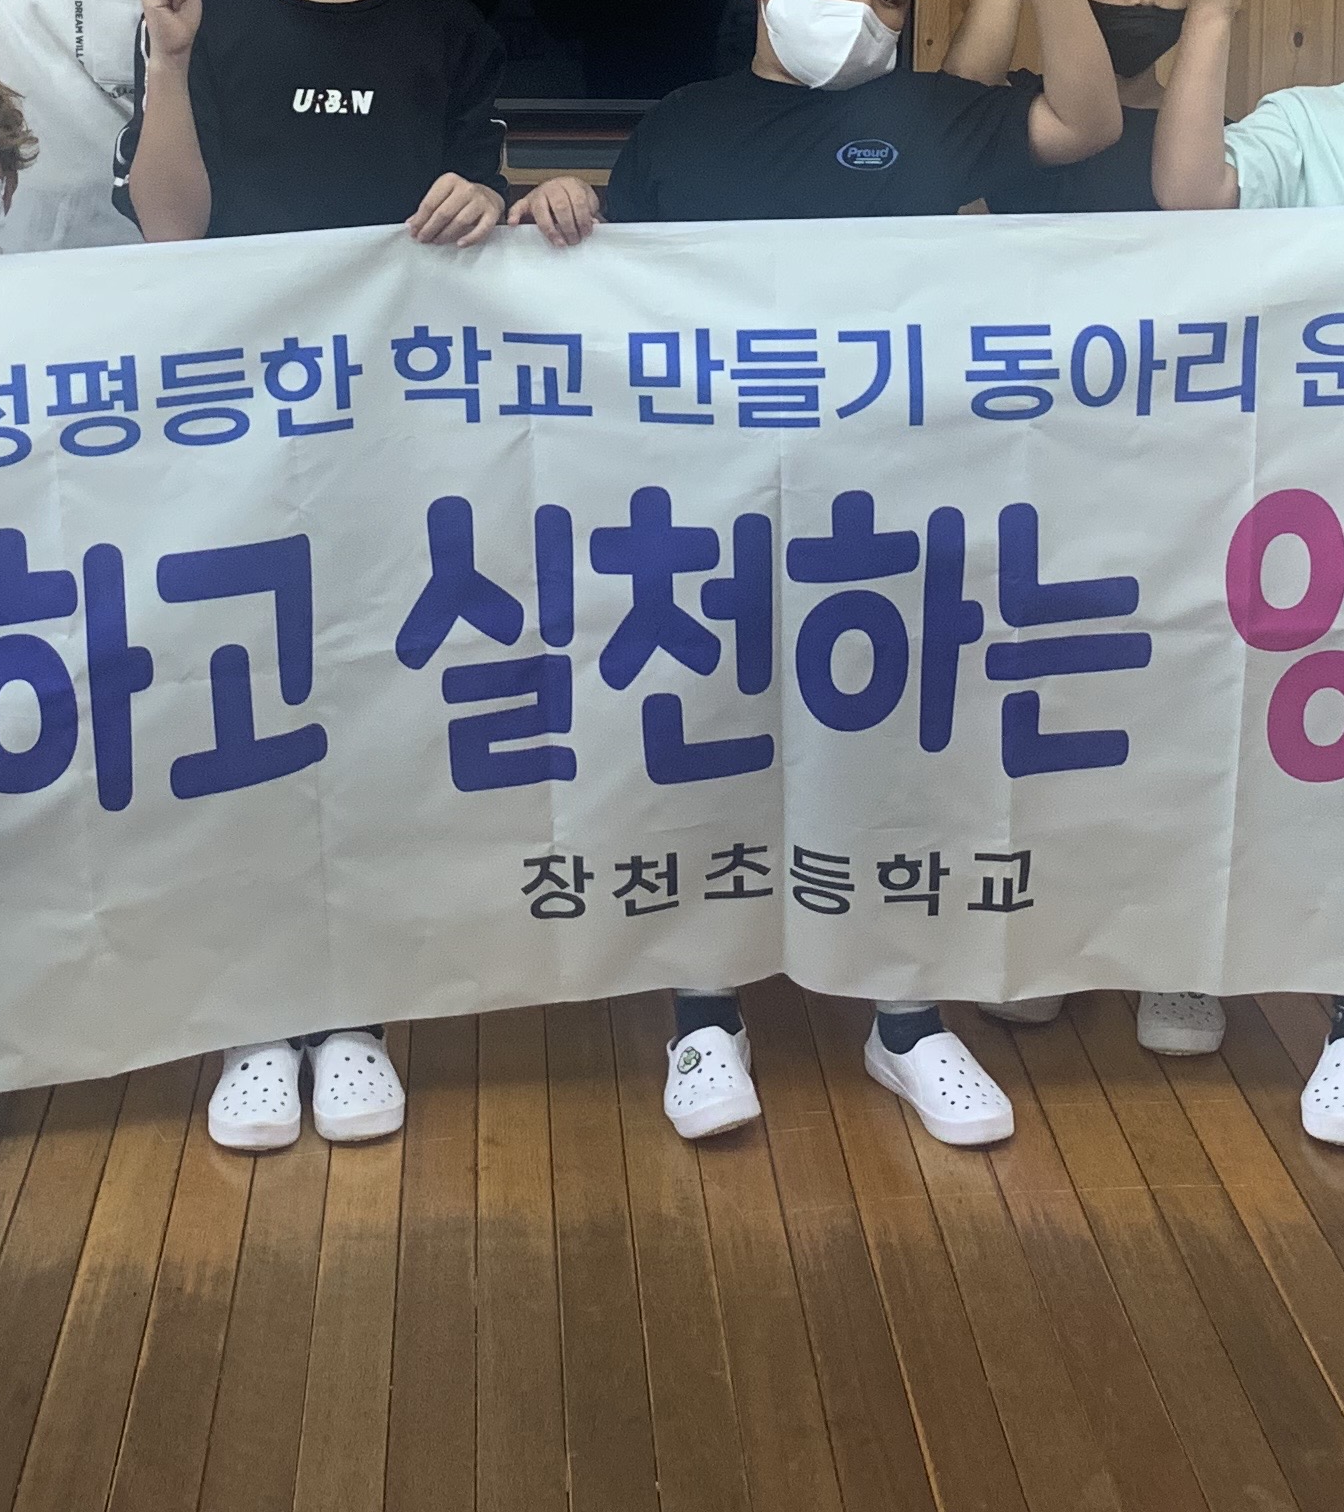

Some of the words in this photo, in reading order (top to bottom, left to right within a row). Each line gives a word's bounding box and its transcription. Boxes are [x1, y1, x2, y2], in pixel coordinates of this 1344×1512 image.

[74, 0, 84, 34] DREAM
[75, 35, 84, 59] WILL
[847, 146, 890, 158] Proud
[391, 325, 594, 425] 학교
[627, 323, 926, 430] 만들기
[964, 316, 1259, 421] 동아리
[395, 486, 1153, 793] 실천하는
[521, 842, 1036, 920] 장천초등학교
